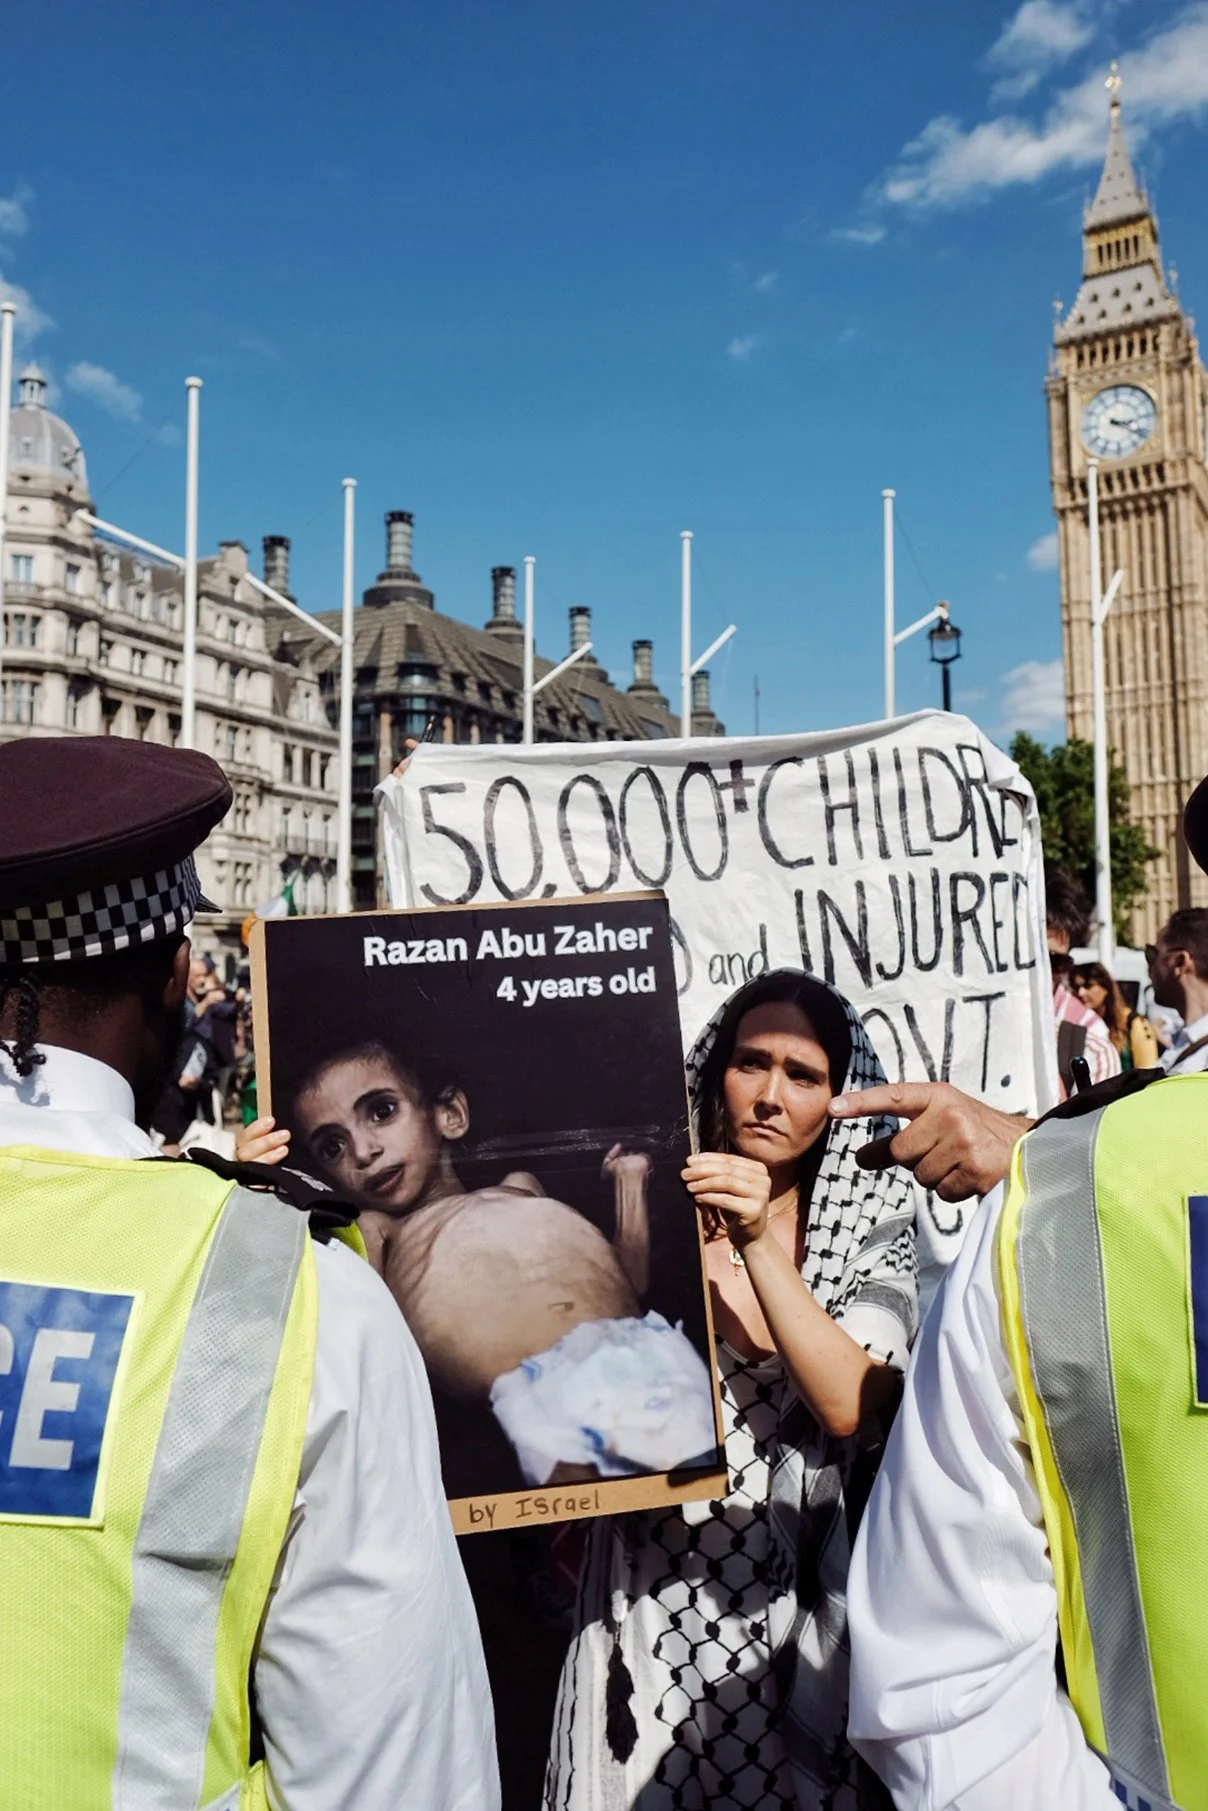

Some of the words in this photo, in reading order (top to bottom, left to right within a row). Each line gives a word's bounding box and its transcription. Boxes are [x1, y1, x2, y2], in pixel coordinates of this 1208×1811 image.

[363, 936, 468, 967] Razan
[475, 928, 546, 960] Abu
[553, 922, 653, 956] Zaher
[708, 922, 770, 986] and
[496, 976, 517, 1001] 4
[521, 974, 603, 1007] years
[608, 966, 657, 995] old
[861, 992, 1011, 1093] OVT.
[468, 1503, 497, 1528] by
[515, 1489, 601, 1518] Israel
